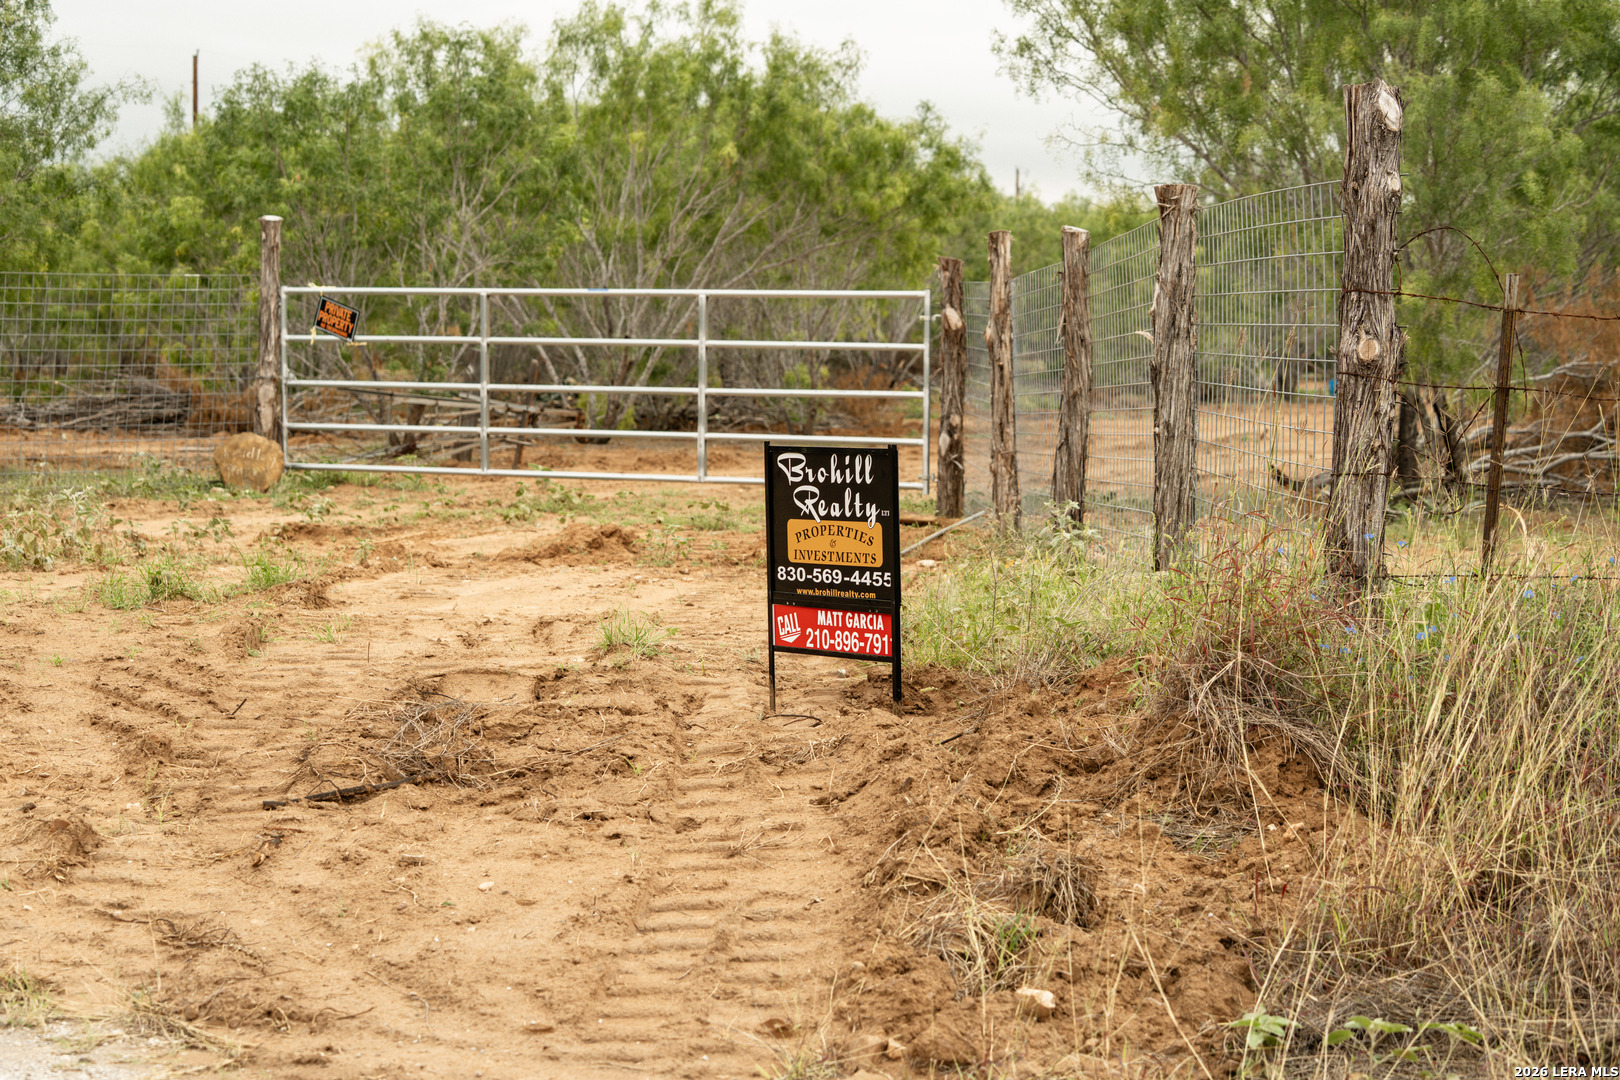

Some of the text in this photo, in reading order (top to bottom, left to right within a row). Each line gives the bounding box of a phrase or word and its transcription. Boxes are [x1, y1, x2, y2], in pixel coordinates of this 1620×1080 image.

[318, 309, 354, 334] PROPERTY
[324, 301, 353, 321] PRIVATE
[777, 452, 874, 486] Brohill
[793, 485, 880, 529] Realty
[795, 524, 875, 547] PROPERTIES
[829, 539, 837, 548] &
[793, 549, 877, 565] INVESTMENTS
[777, 566, 891, 587] 830-569-4455
[796, 588, 876, 599] www.brohillrealty.com
[777, 612, 801, 636] CALL
[817, 610, 884, 631] MATT GARCIA
[806, 628, 892, 655] 210-896-791
